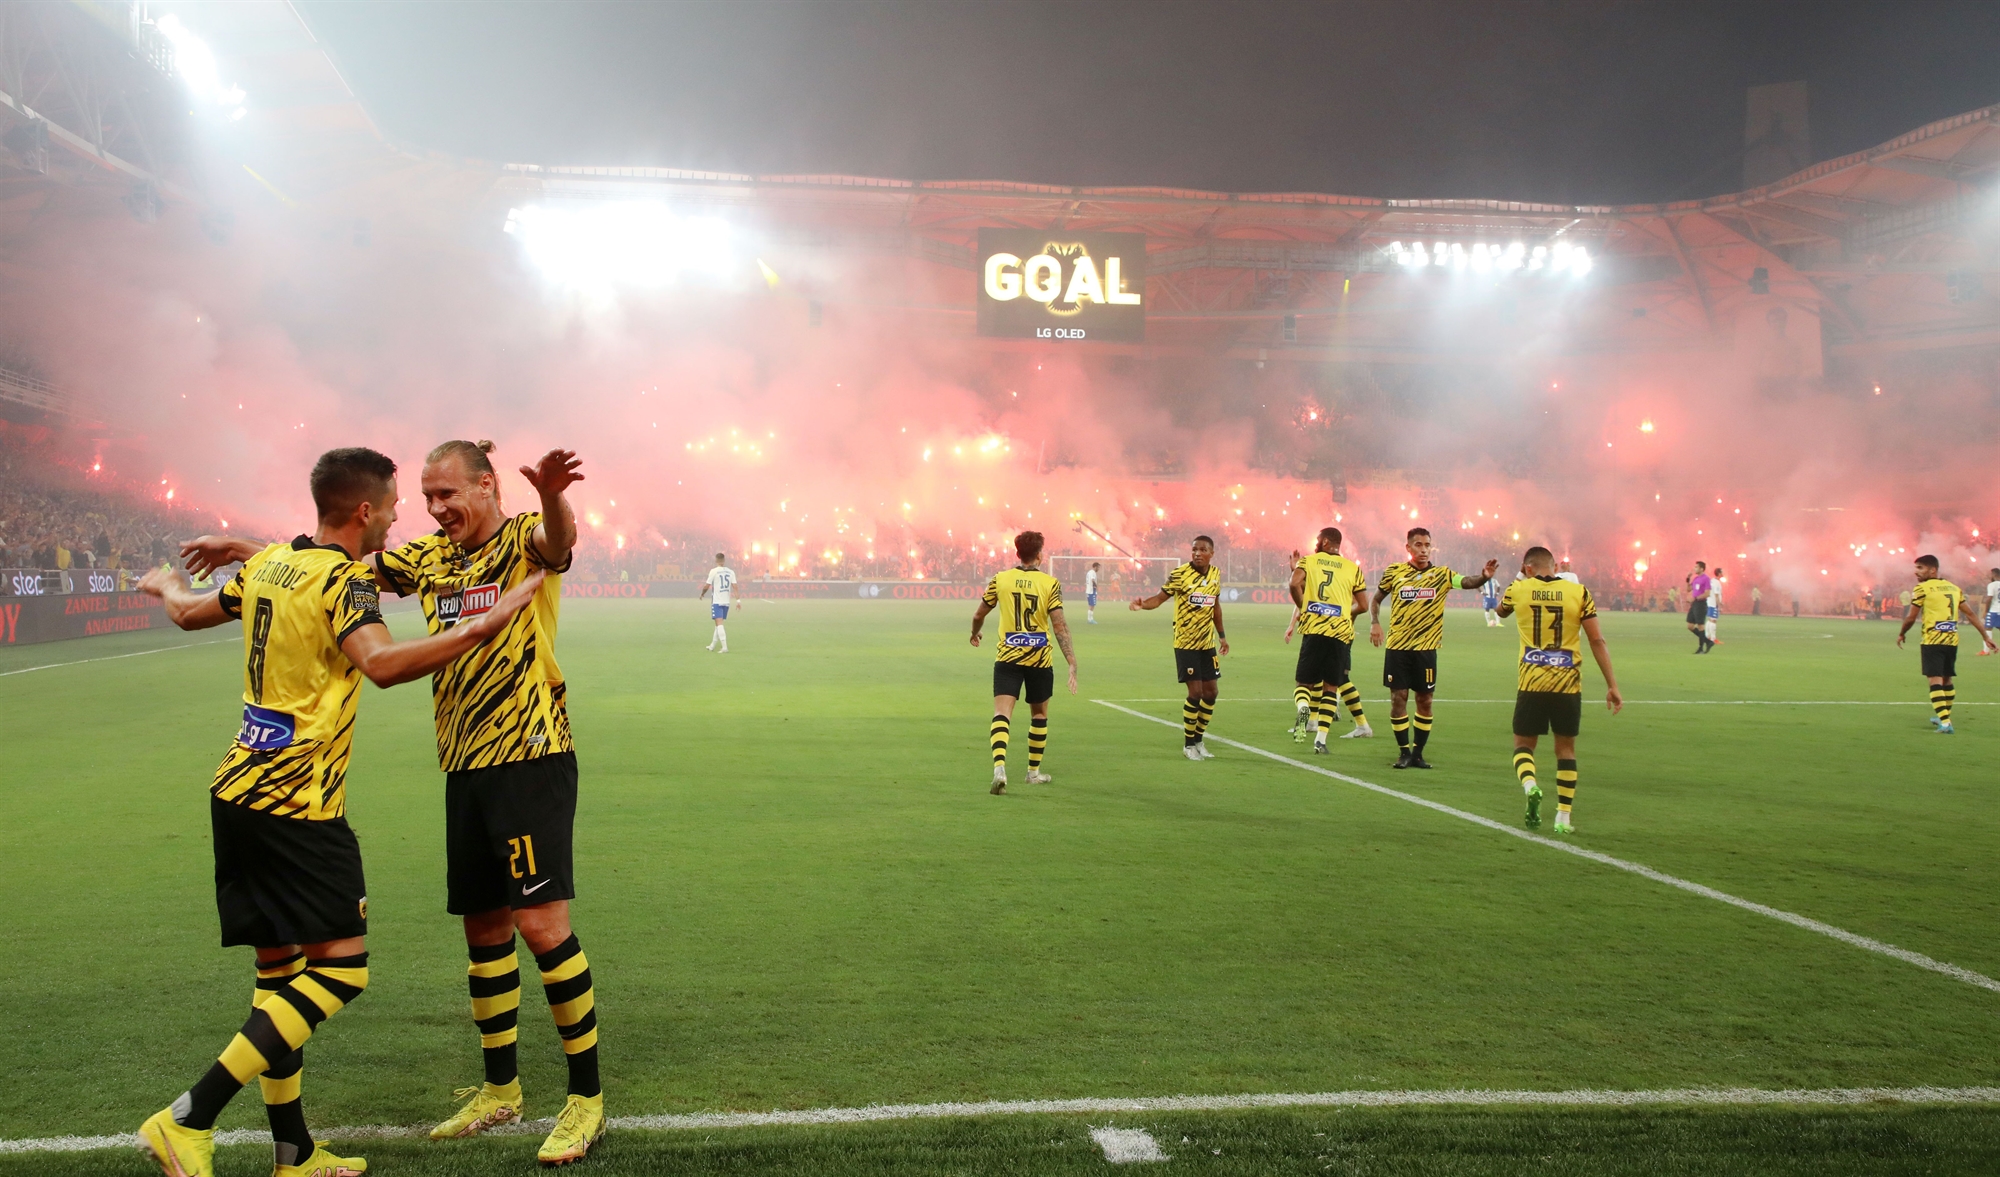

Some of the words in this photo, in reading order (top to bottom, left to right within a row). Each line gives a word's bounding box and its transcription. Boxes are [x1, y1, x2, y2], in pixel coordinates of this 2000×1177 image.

[985, 253, 1141, 305] GOAL
[1036, 328, 1051, 338] LG
[1055, 328, 1086, 339] OLED
[719, 574, 731, 589] 15
[1318, 570, 1333, 602] 2
[1531, 590, 1563, 602] ORBELIN
[1012, 592, 1039, 632] 12
[1529, 604, 1564, 651] 13
[249, 596, 273, 704] 8
[1425, 667, 1434, 684] 11
[508, 834, 537, 879] 21
